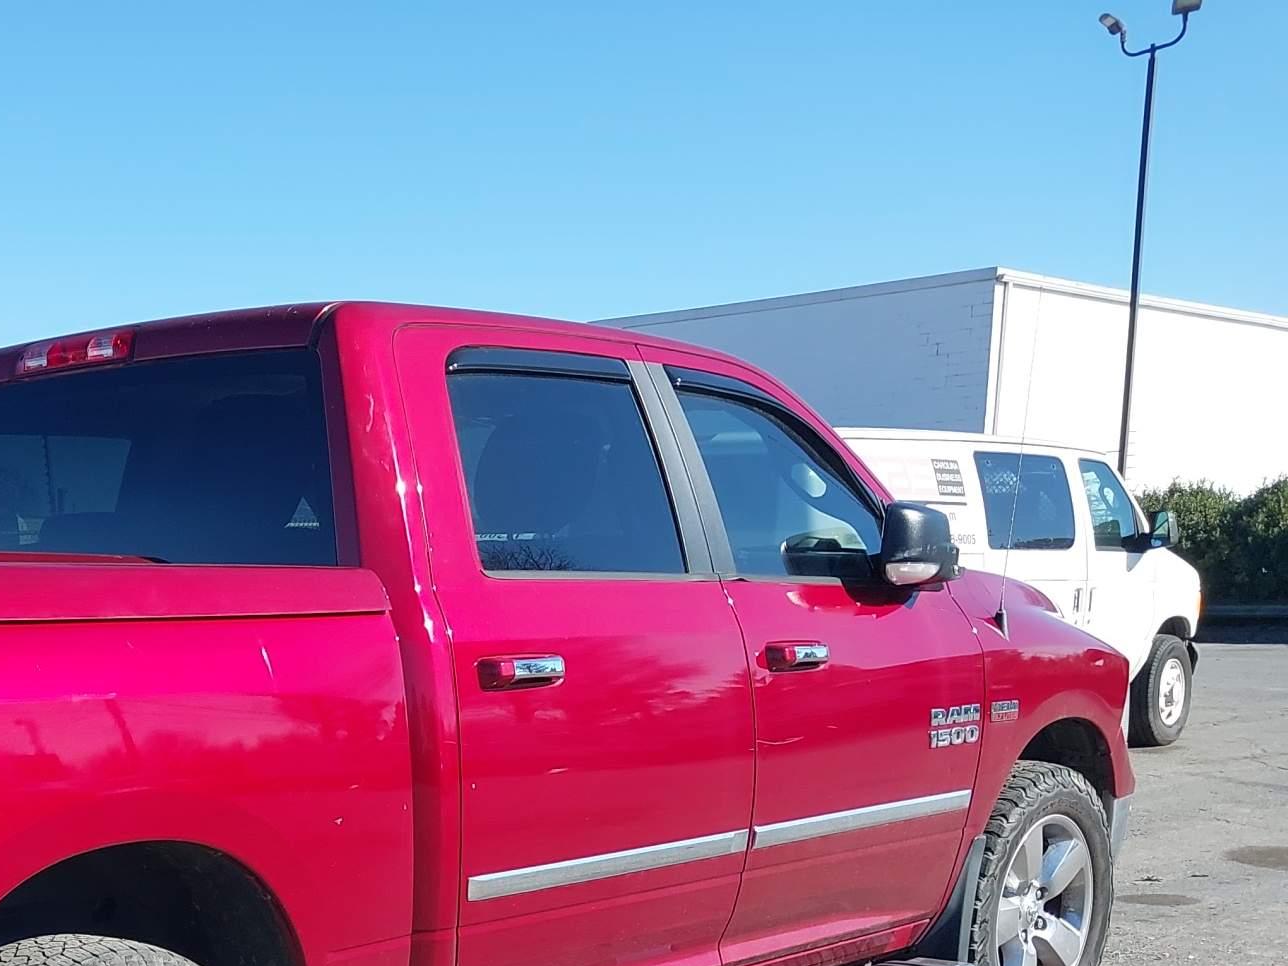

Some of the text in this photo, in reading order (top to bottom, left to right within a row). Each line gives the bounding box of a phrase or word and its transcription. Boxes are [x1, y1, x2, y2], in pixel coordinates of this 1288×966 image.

[934, 461, 958, 469] CAROLINA
[938, 485, 964, 494] EQUIPMENT
[931, 704, 980, 726] RAM
[930, 726, 979, 748] 1500
